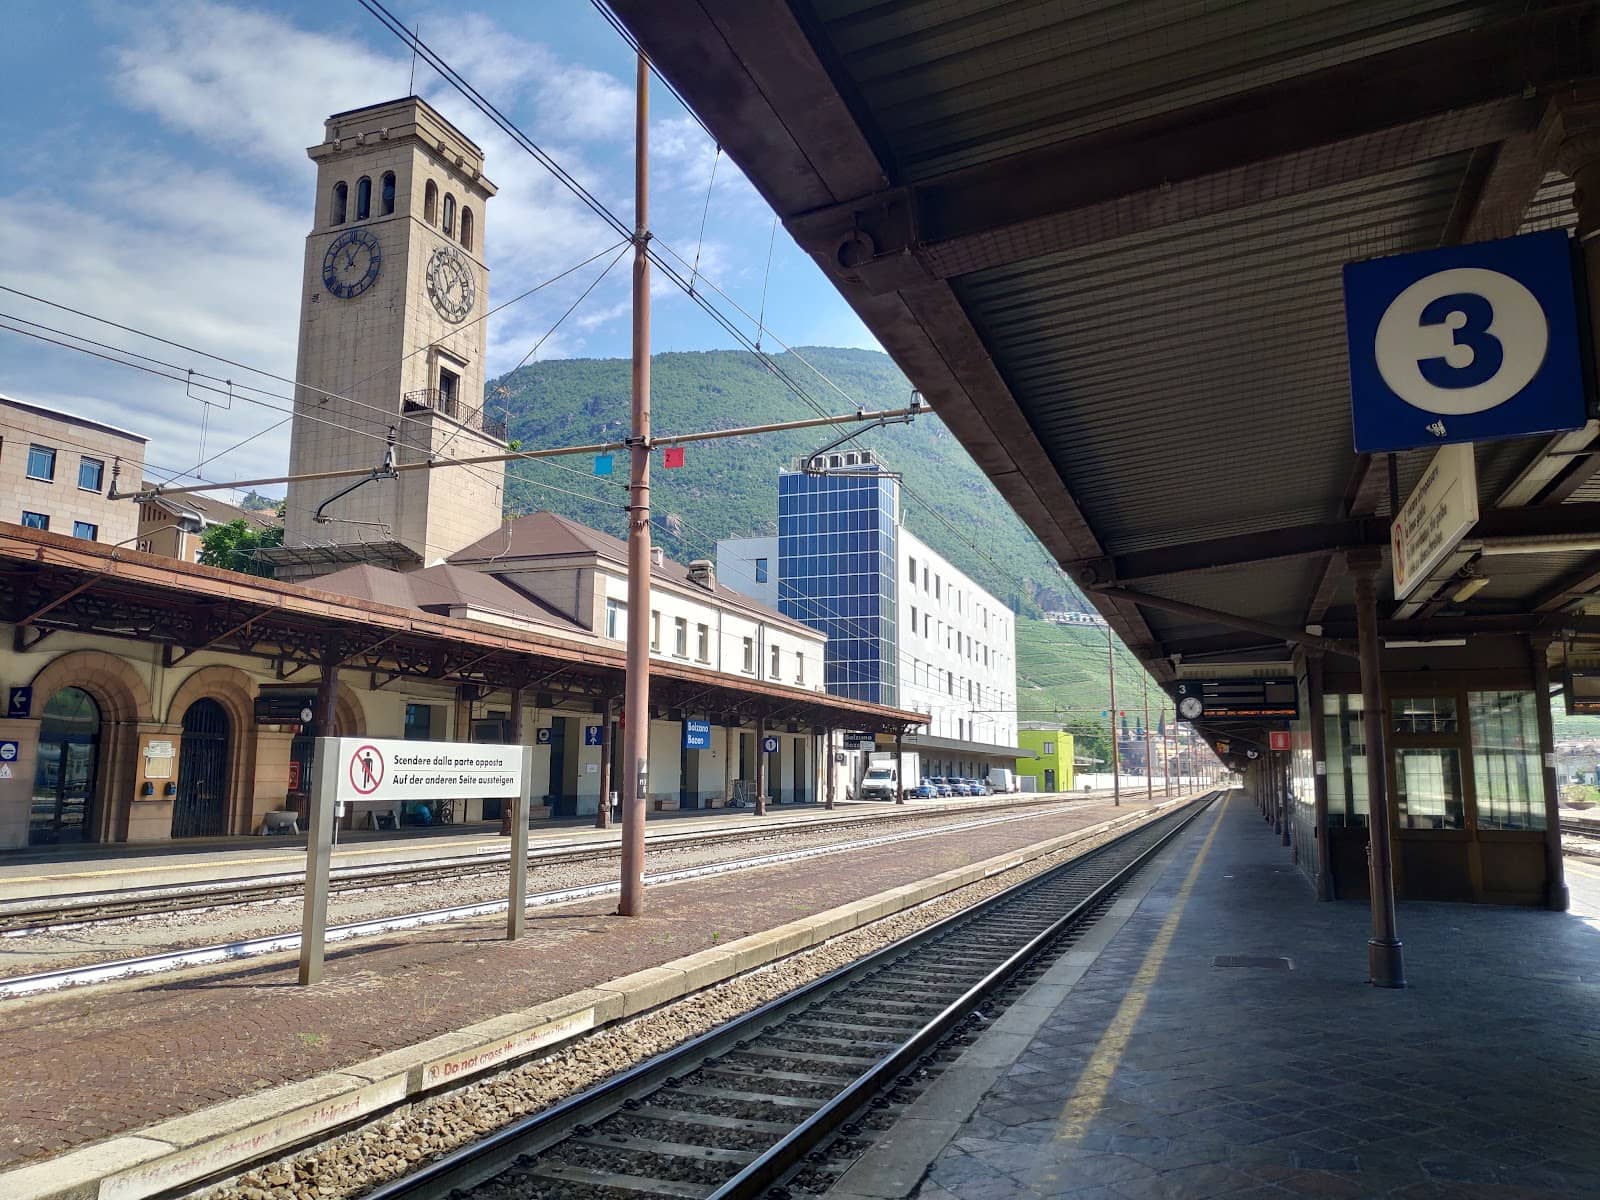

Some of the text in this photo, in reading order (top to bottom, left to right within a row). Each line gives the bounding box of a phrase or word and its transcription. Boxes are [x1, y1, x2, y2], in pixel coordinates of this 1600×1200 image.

[1416, 292, 1504, 390] 3
[1179, 684, 1186, 694] 3
[688, 721, 709, 733] Bolzano
[844, 733, 873, 741] Bolzano
[393, 754, 503, 769] Scendere dalla parte opposta
[392, 773, 514, 786] Auf der anderen Seite aussteigen
[443, 1061, 458, 1076] Do
[461, 1056, 479, 1071] not
[479, 1048, 504, 1066] cross
